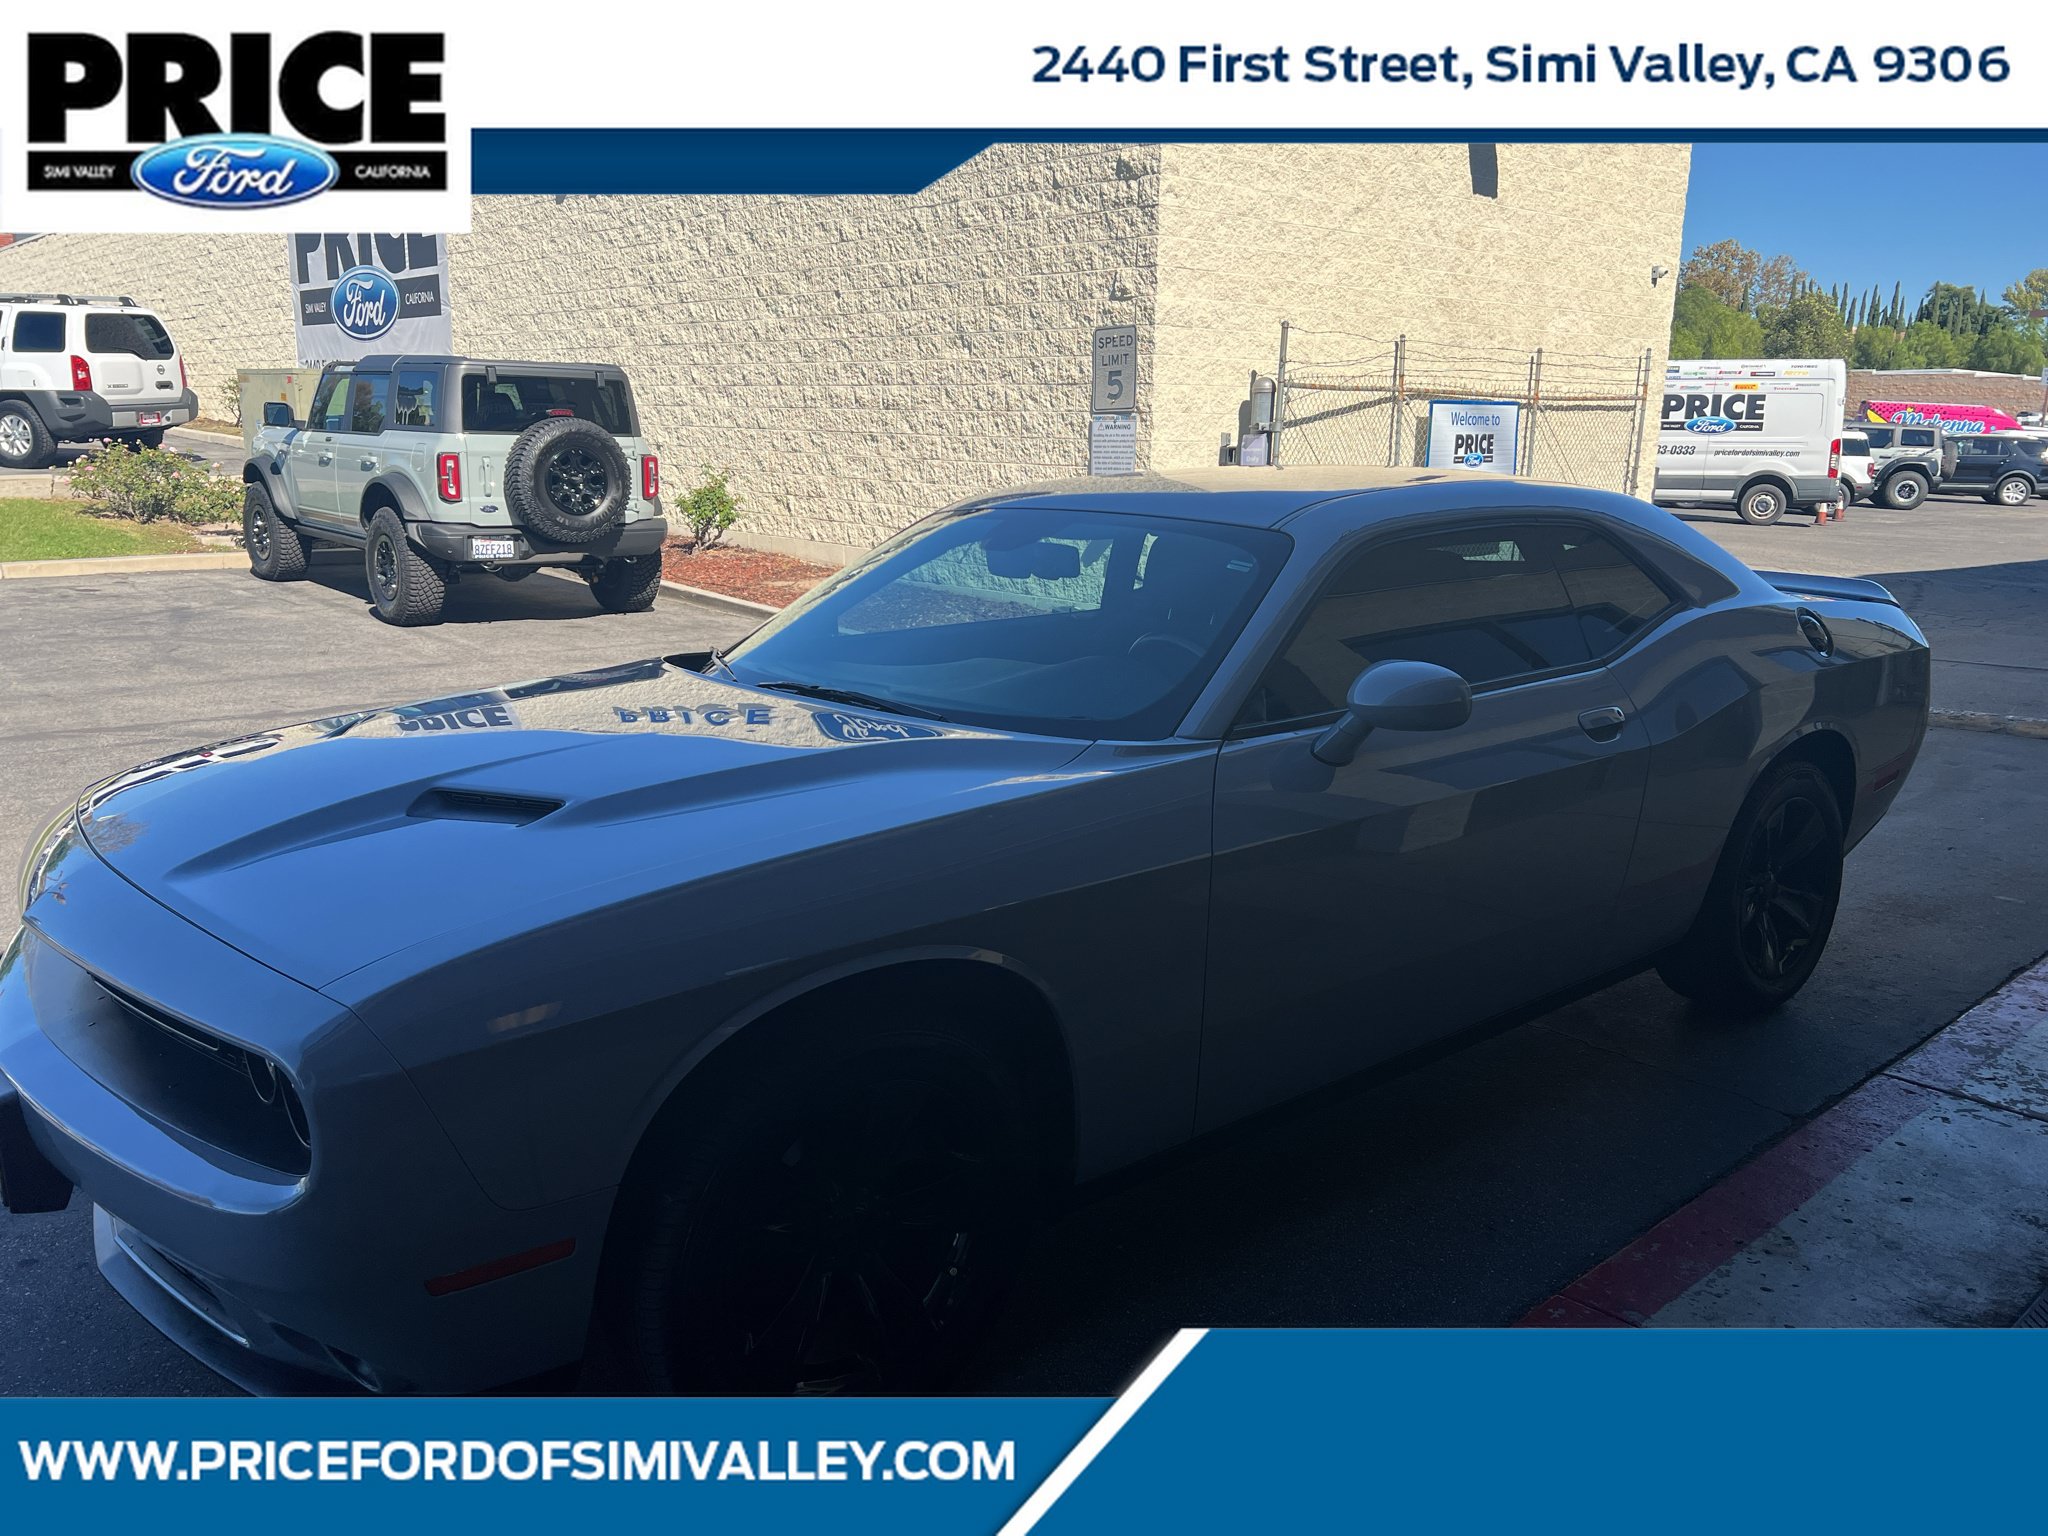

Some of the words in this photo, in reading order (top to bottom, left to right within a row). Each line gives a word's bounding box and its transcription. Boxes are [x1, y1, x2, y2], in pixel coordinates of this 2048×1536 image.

[343, 278, 387, 328] Ford
[405, 290, 435, 305] CALIFORNIA
[1097, 335, 1134, 349] SPEED
[1101, 353, 1130, 367] LIMIT
[1106, 370, 1124, 401] 5
[1662, 394, 1767, 420] PRICE
[1451, 411, 1489, 426] Welcome
[1491, 414, 1501, 426] to
[1693, 418, 1726, 433] Ford
[1104, 423, 1132, 431] WARNING
[1454, 434, 1494, 455] PRICE
[475, 543, 512, 555] 8ZFF218
